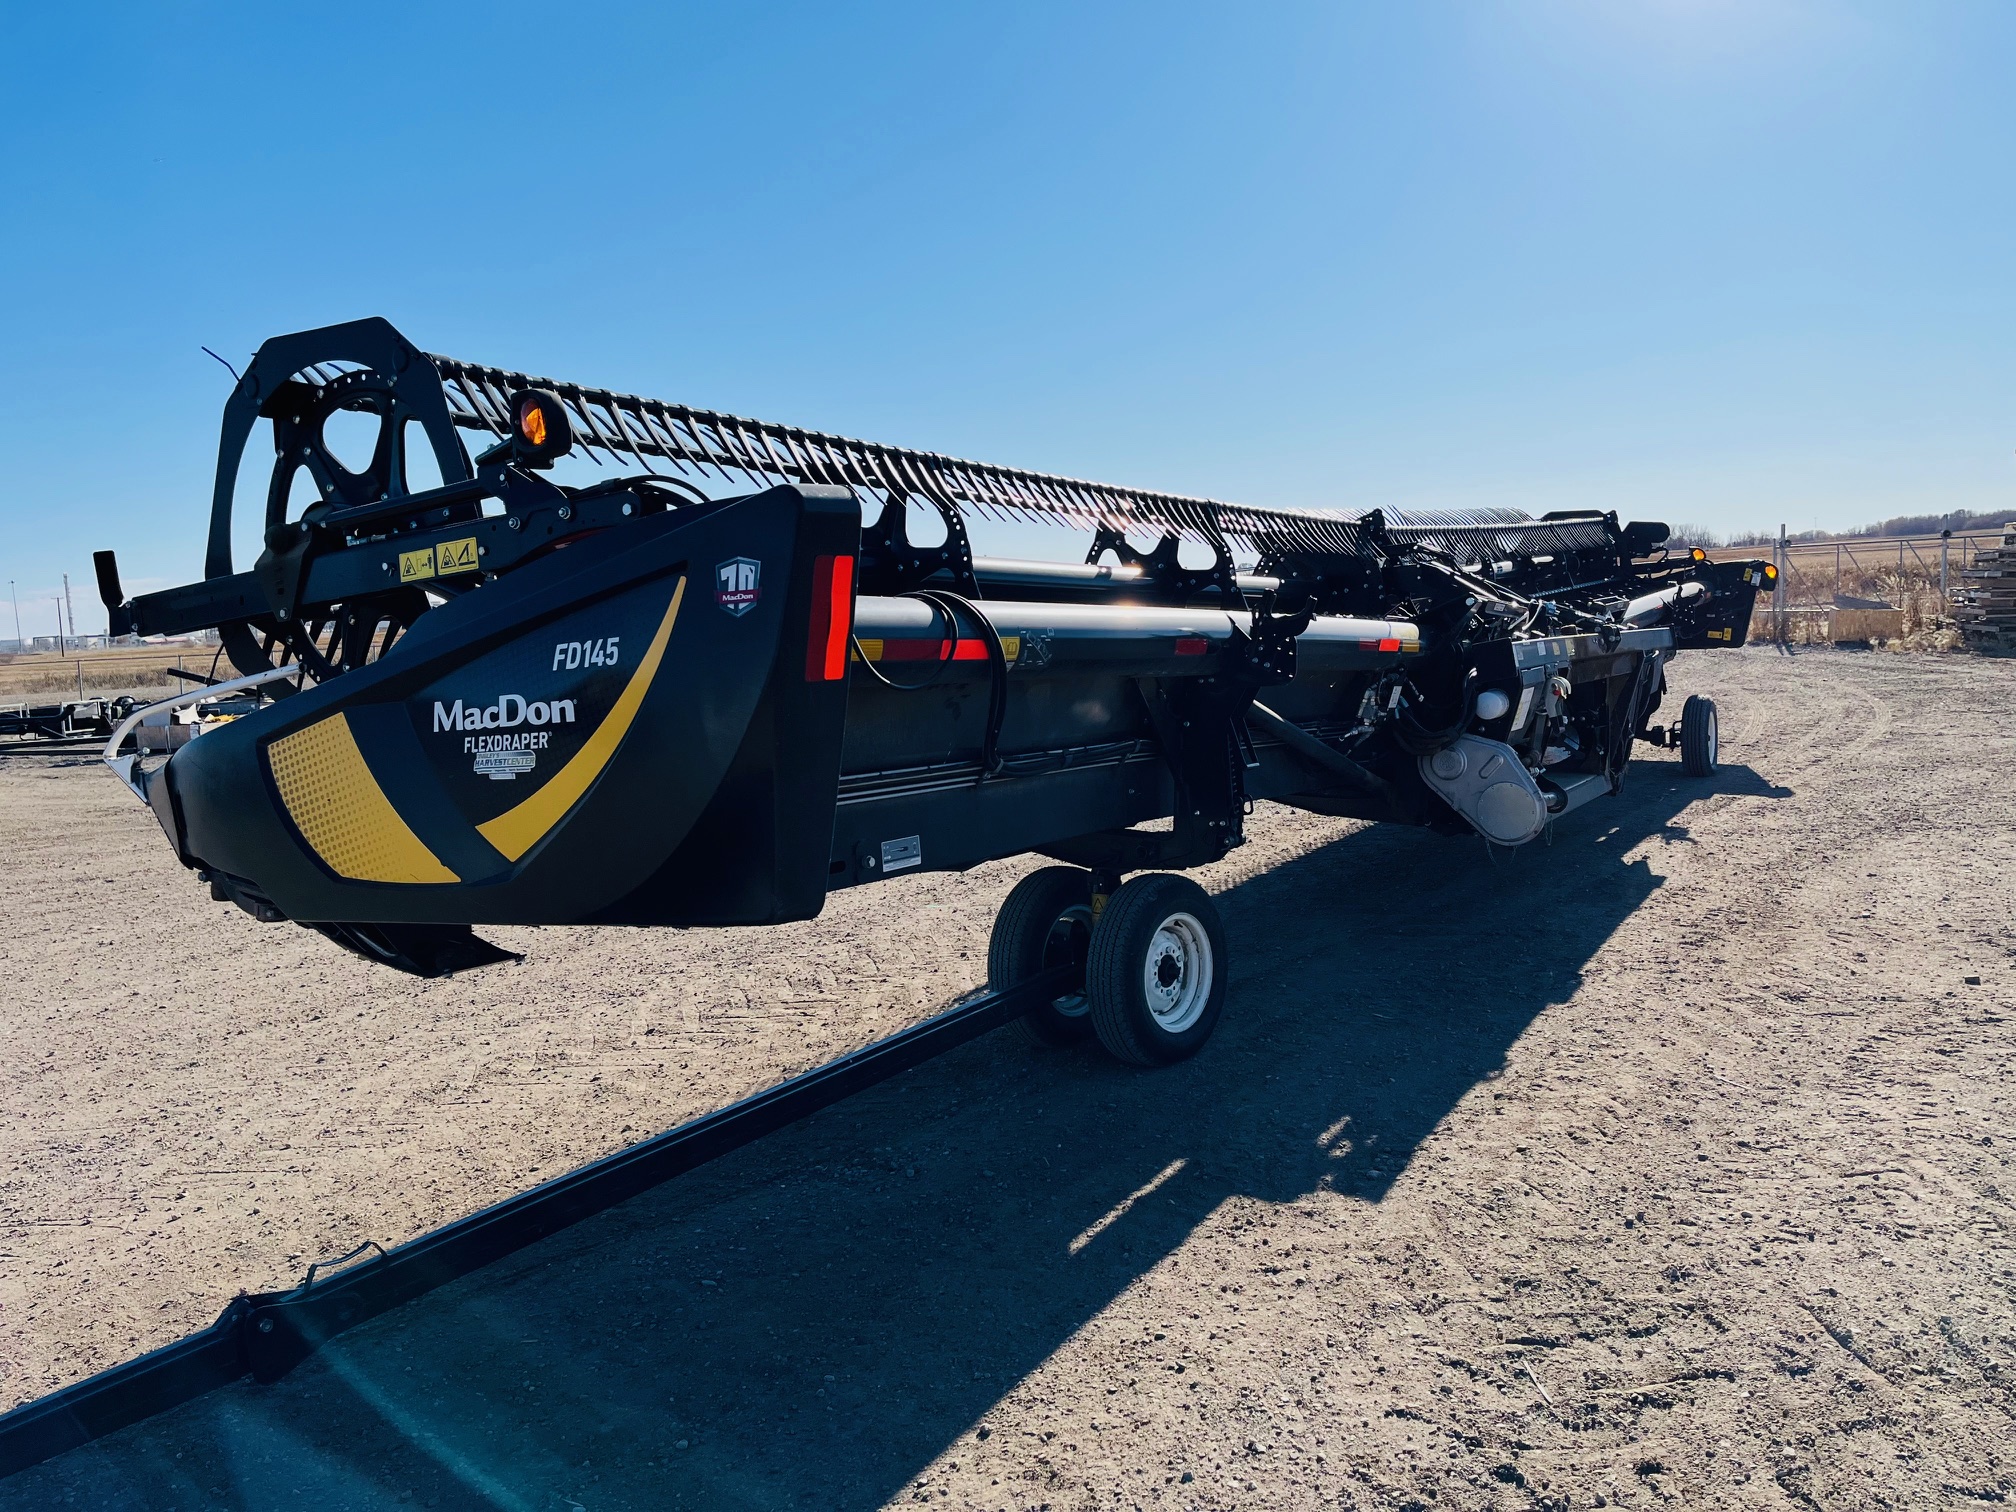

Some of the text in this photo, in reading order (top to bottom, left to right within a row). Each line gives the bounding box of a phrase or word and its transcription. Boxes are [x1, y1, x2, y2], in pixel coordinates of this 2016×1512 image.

[722, 593, 754, 602] MacDon
[552, 636, 620, 671] FD145
[433, 694, 576, 732] MacDon
[464, 731, 549, 754] FLEXDRAPER
